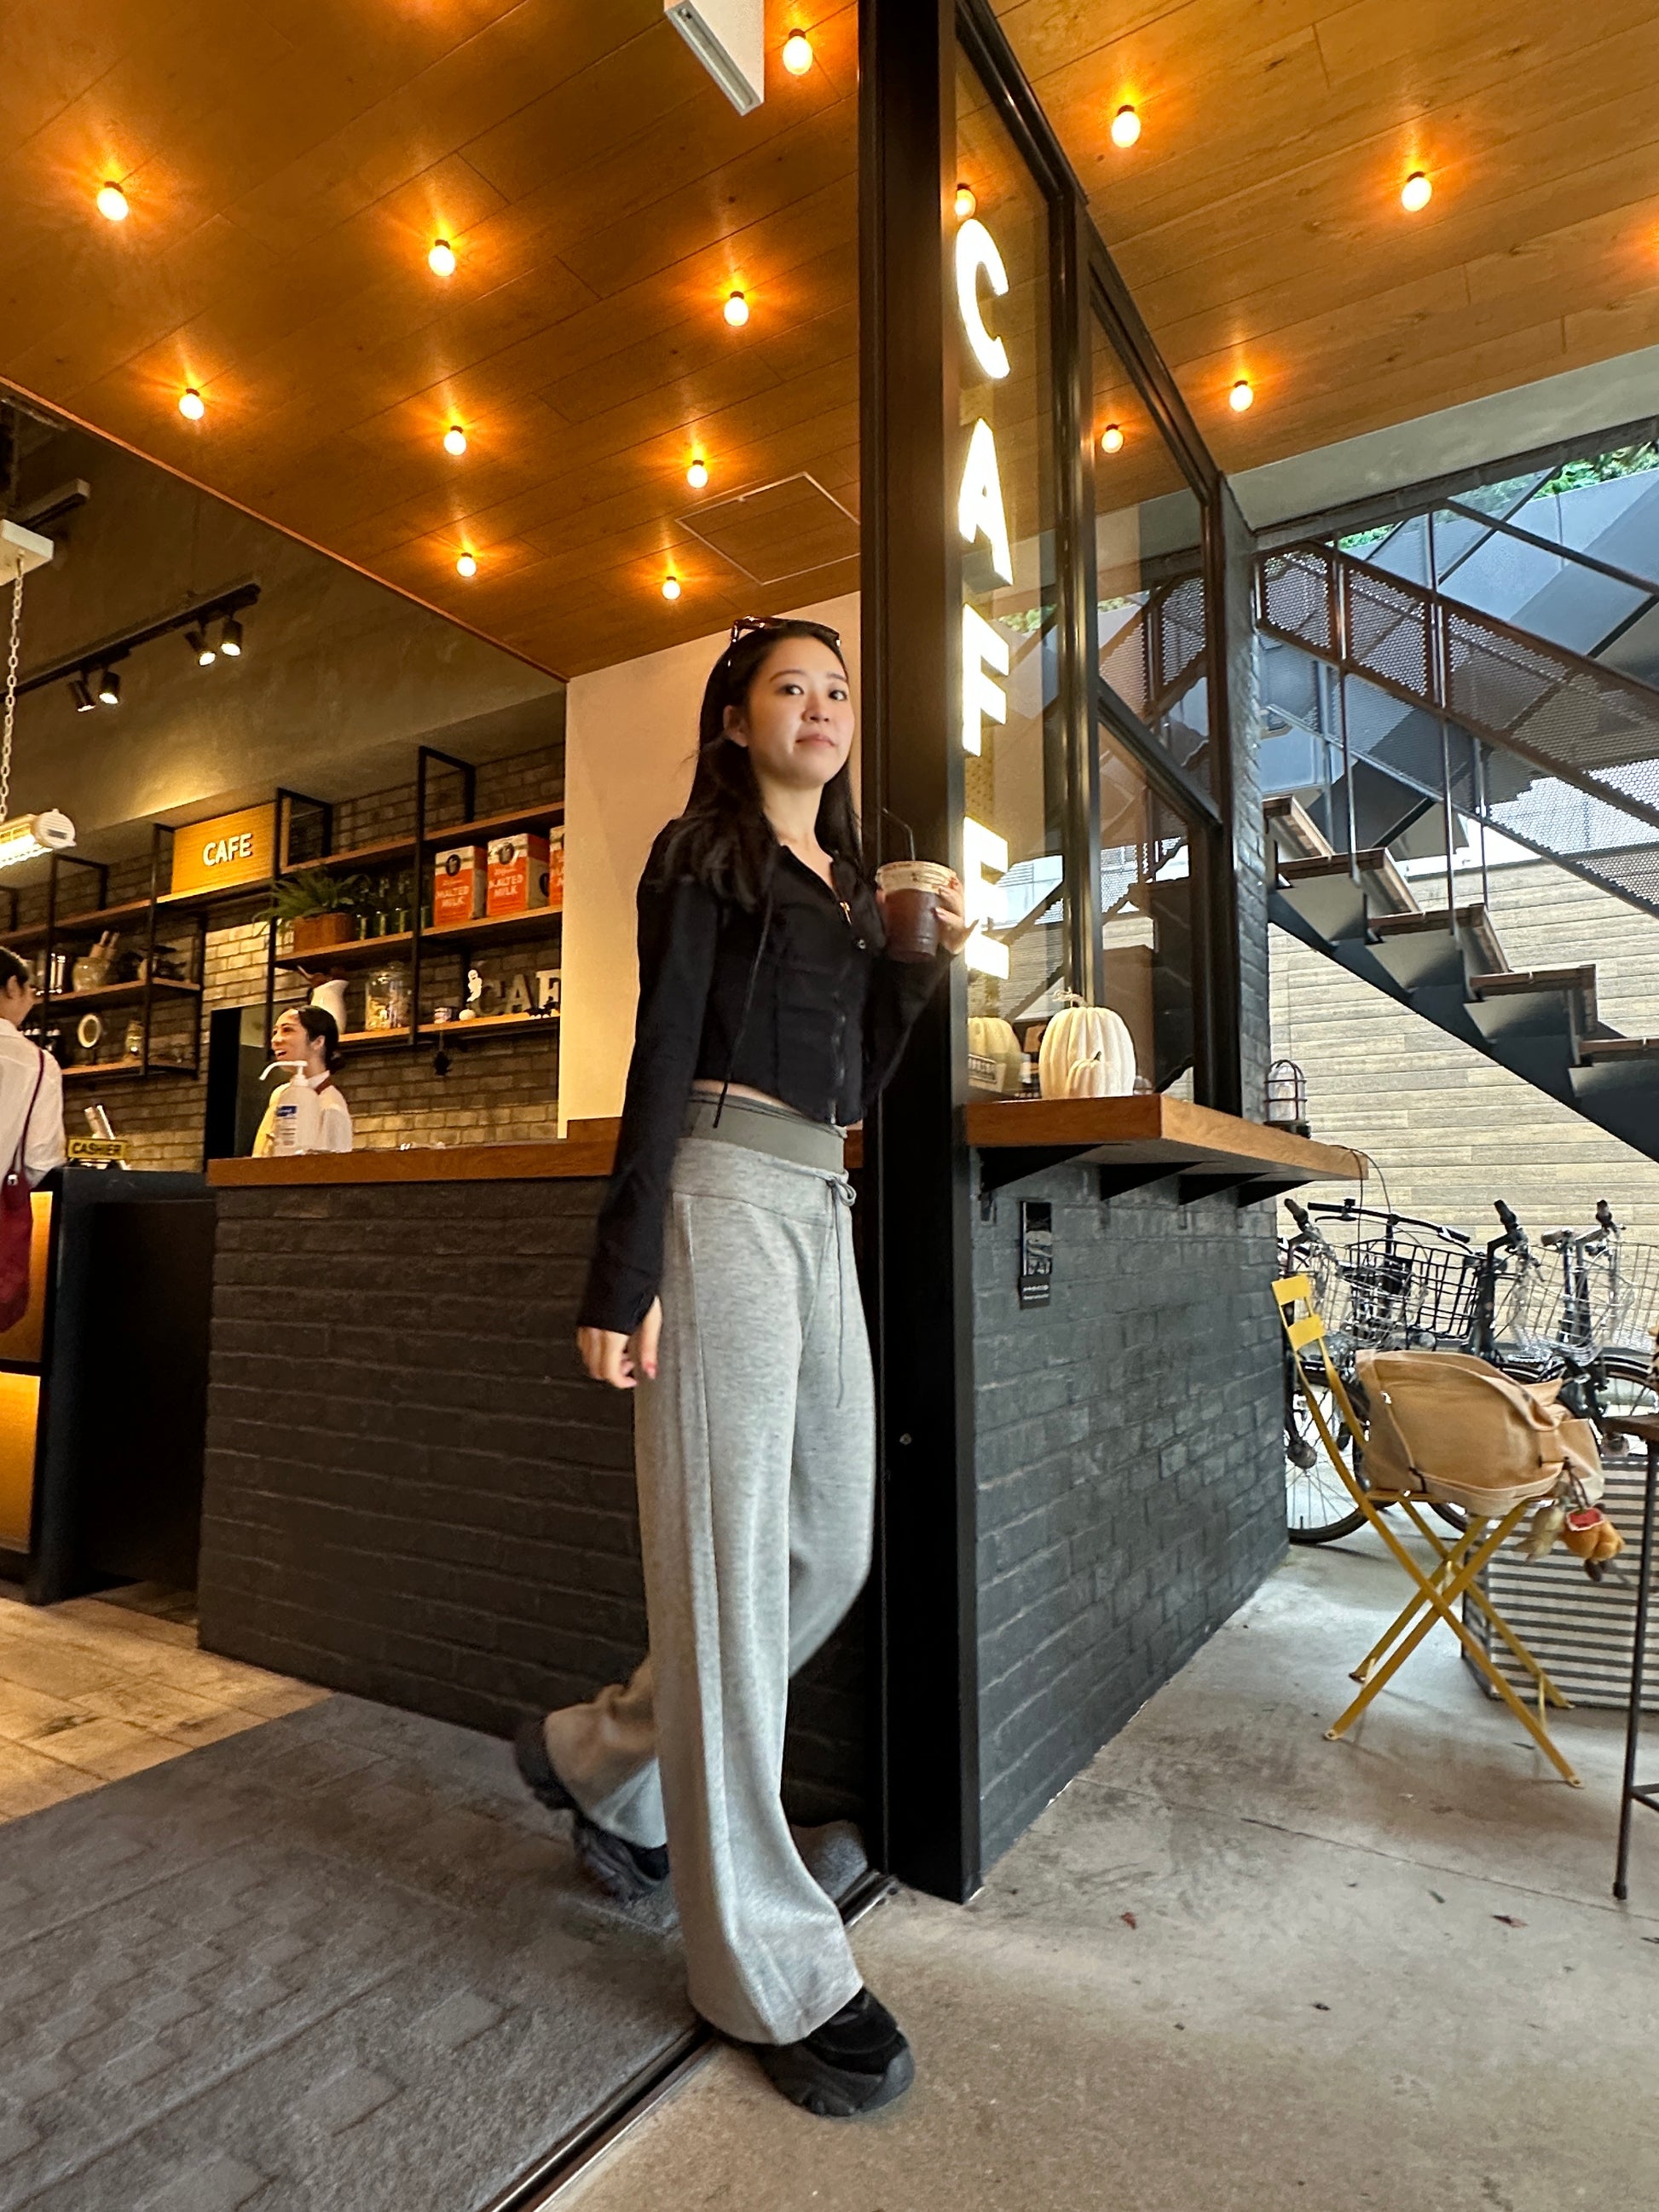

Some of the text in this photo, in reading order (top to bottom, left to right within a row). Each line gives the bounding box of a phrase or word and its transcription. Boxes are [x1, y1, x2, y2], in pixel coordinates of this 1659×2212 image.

[956, 219, 1013, 979] CAFE
[203, 833, 252, 866] CAFE
[494, 885, 518, 898] MILK
[442, 896, 465, 908] MILK
[73, 1142, 122, 1155] CASHIER
